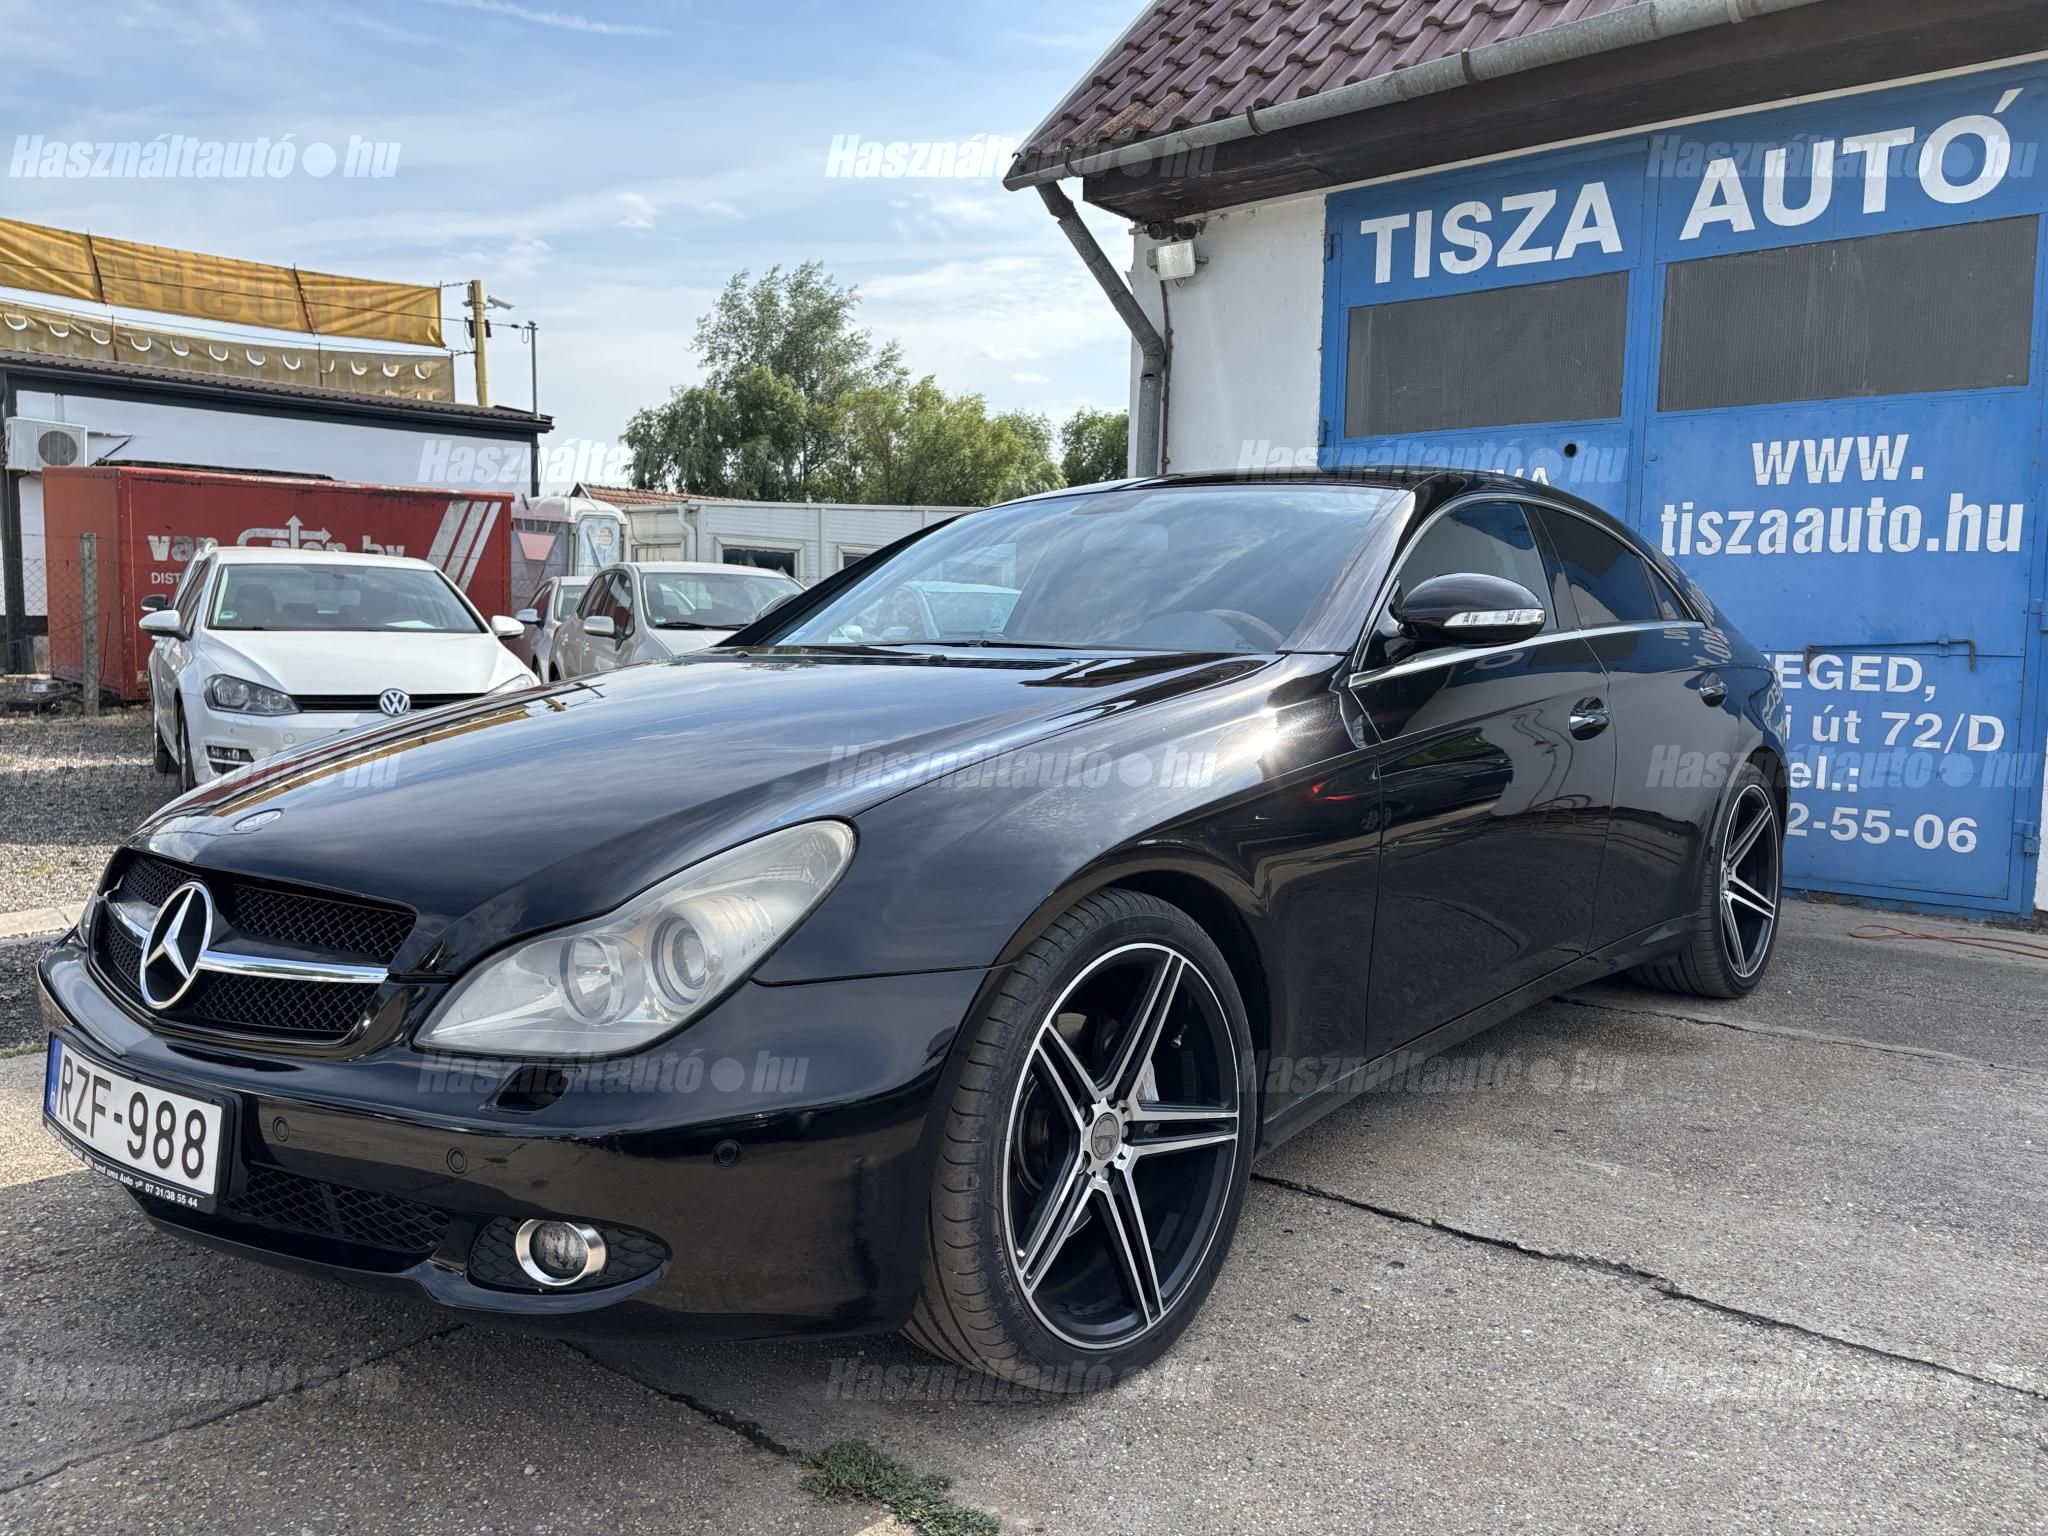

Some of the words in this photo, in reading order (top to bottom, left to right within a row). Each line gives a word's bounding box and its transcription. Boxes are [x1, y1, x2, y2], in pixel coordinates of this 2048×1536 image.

[1360, 182, 1623, 284] TISZA
[1679, 88, 2023, 241] AUTÓ
[1752, 434, 1924, 486] www.
[1660, 493, 2024, 557] tiszaauto.hu
[1764, 654, 1936, 702] EGED,
[1812, 704, 1861, 744] út
[1881, 712, 2005, 754] 72/D
[1787, 802, 1977, 853] 2-55-06
[60, 1055, 207, 1180] RZF-988
[120, 1173, 134, 1186] Auto
[145, 1183, 154, 1193] 07
[155, 1186, 175, 1201] 31/38
[177, 1193, 187, 1204] 55
[187, 1197, 198, 1208] 44
